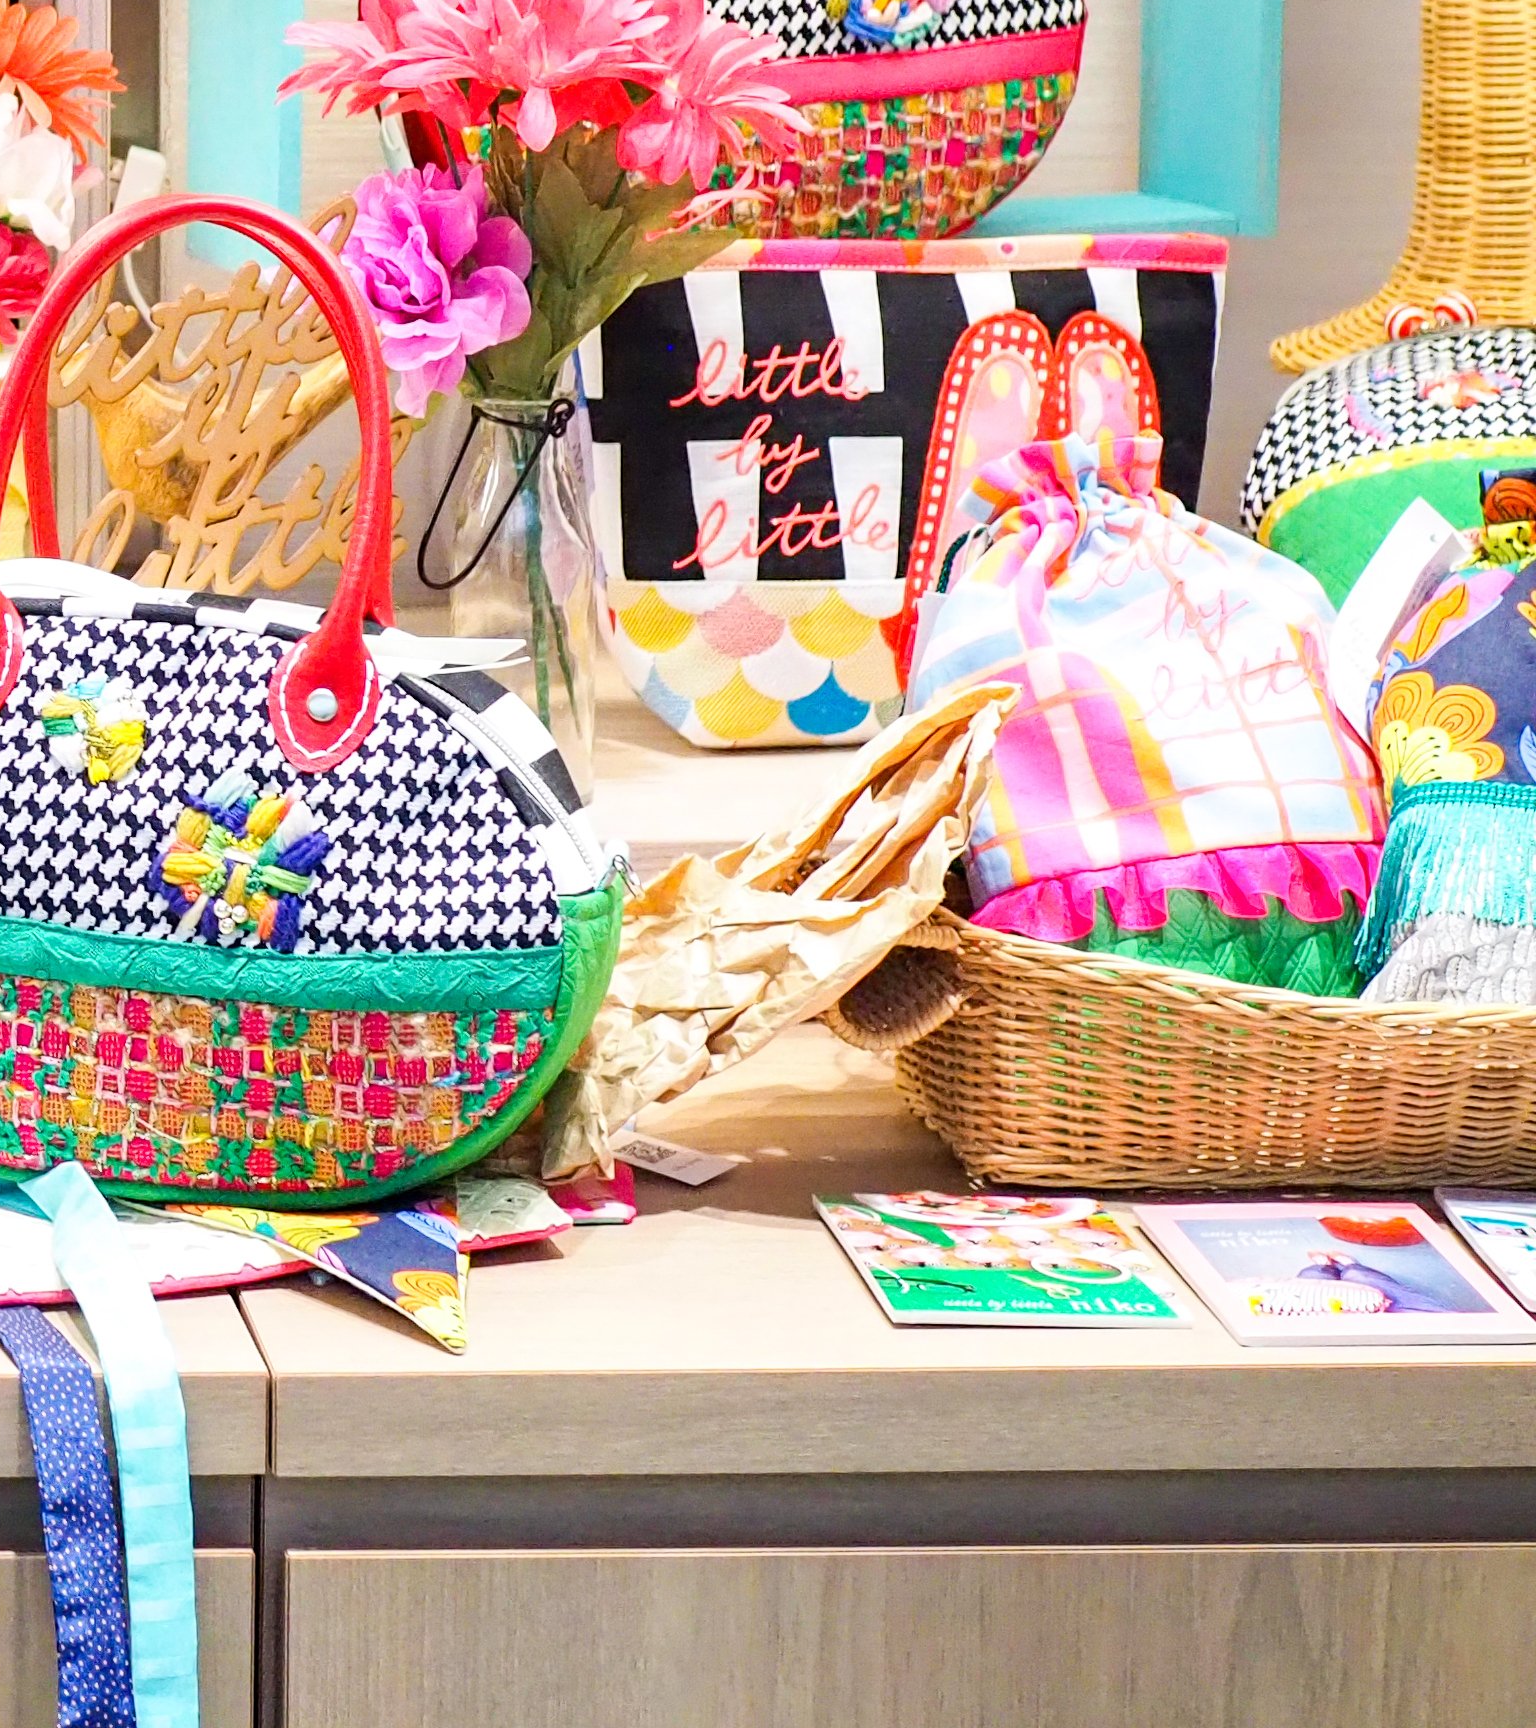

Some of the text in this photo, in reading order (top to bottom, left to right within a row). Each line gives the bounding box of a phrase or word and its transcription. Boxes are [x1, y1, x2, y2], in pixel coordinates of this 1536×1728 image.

[669, 337, 871, 408] little
[716, 413, 821, 493] by
[672, 482, 899, 571] little
[1069, 1297, 1157, 1313] niko
